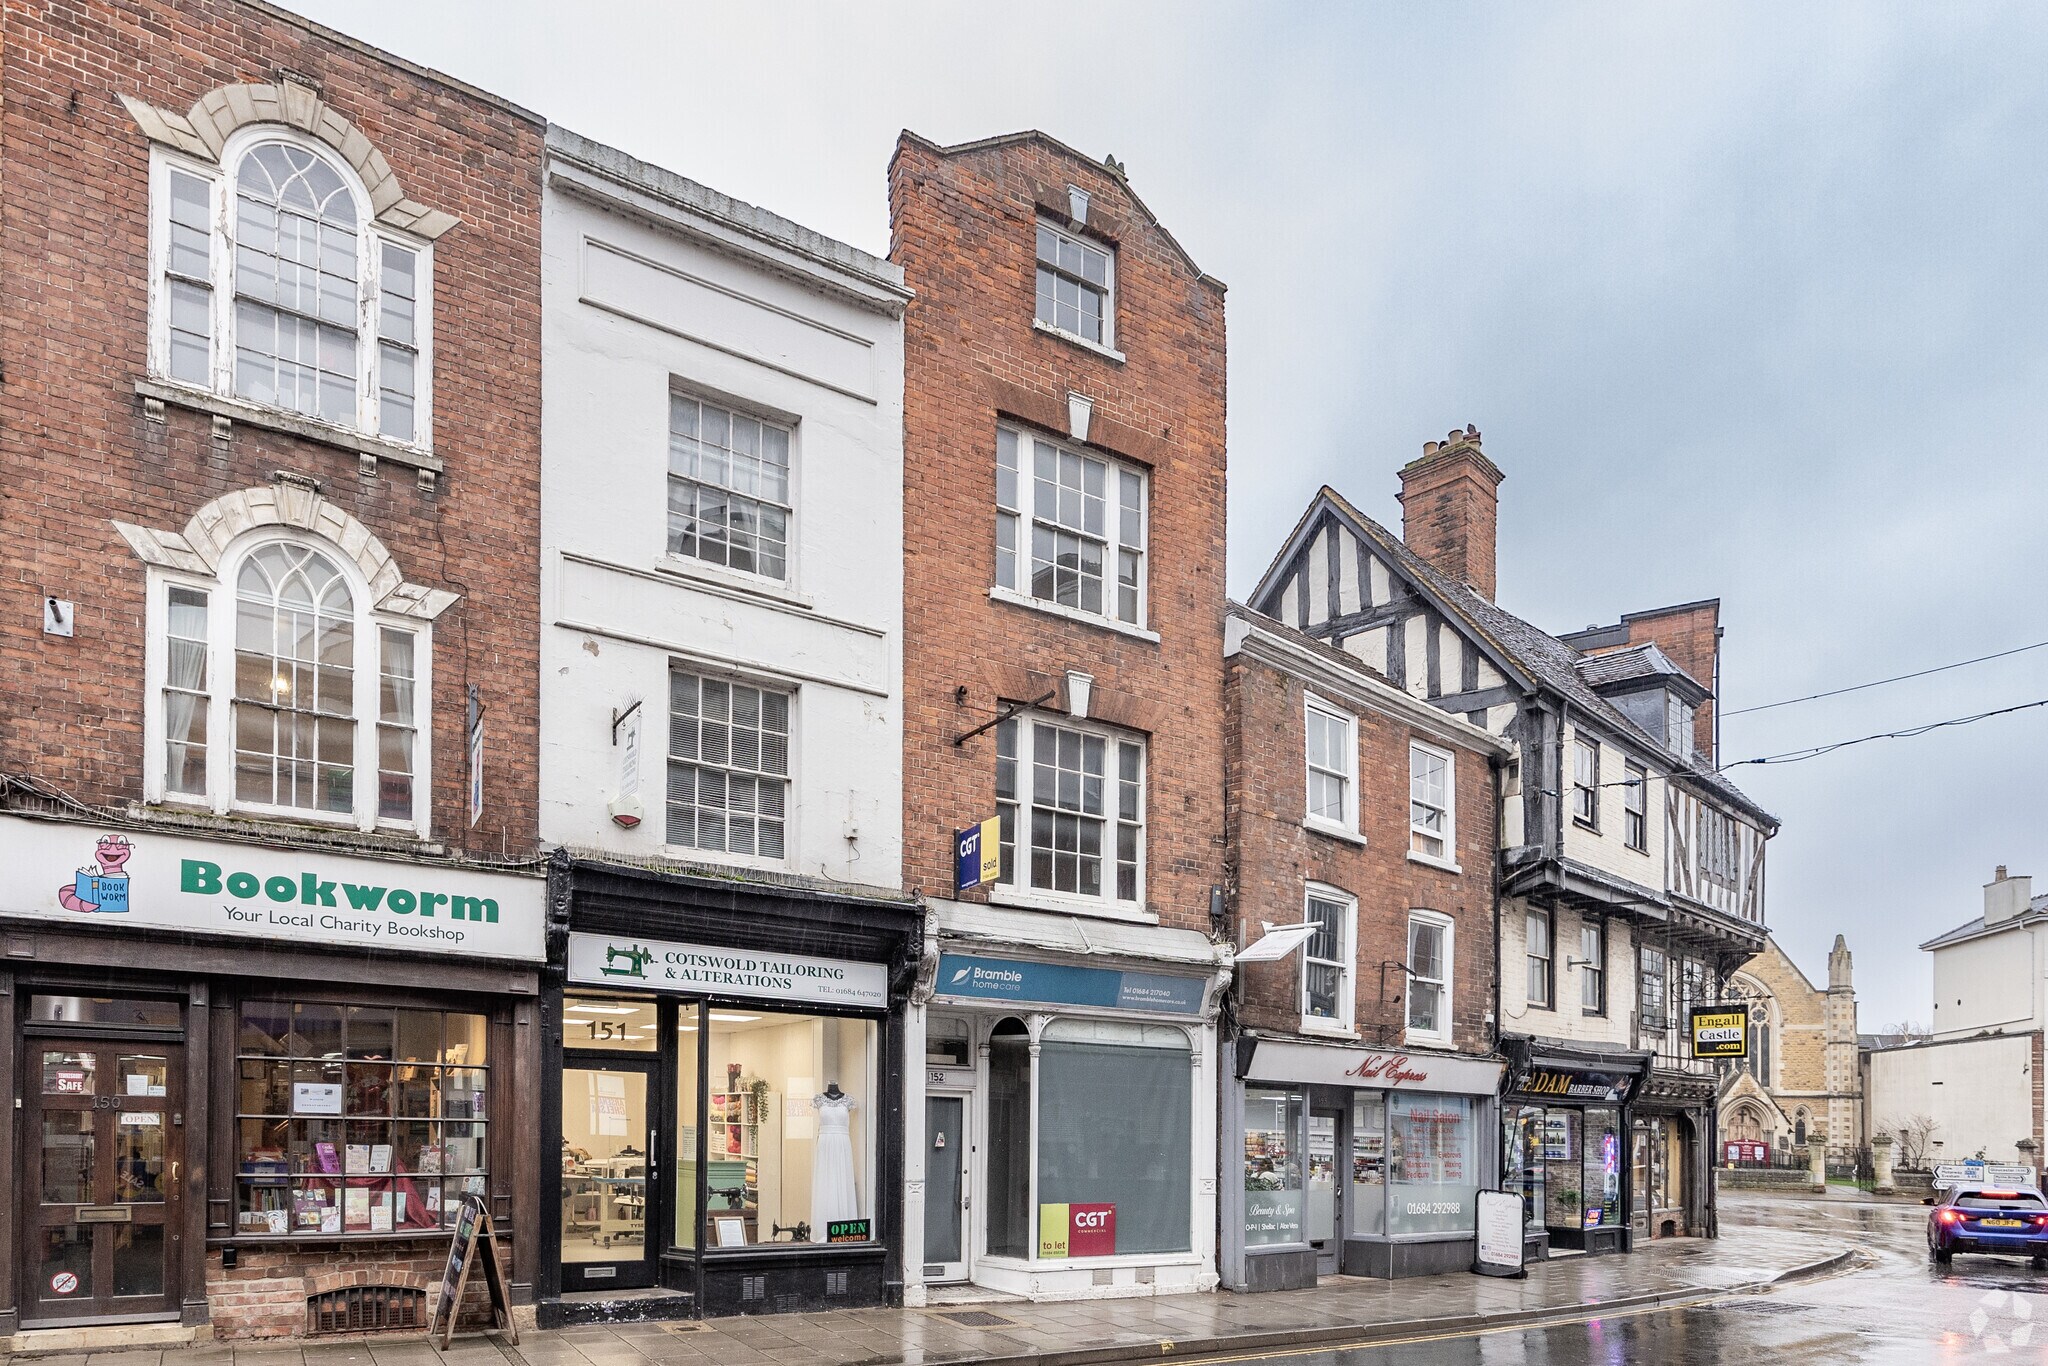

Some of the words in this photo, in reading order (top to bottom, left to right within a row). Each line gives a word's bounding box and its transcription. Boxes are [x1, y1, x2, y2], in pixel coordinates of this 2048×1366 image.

[960, 832, 978, 858] CGT
[983, 857, 996, 871] sold
[102, 882, 124, 892] BOOK
[181, 858, 499, 923] Bookworm
[100, 893, 126, 902] WORM
[223, 905, 263, 923] Your
[269, 910, 314, 928] Local
[320, 915, 382, 937] Charity
[388, 921, 465, 944] Bookshop
[665, 952, 757, 972] COTSWOLD
[760, 961, 844, 980] TAILORING
[665, 967, 677, 979] &
[681, 968, 792, 990] ALTERATIONS
[974, 967, 1022, 982] Bramble
[818, 986, 834, 994] TEL:
[836, 988, 856, 996] 01684
[856, 990, 882, 998] 647020
[1698, 1014, 1740, 1028] Engall
[586, 1021, 626, 1040] 151
[1700, 1029, 1740, 1040] Castle
[930, 1072, 944, 1081] 152
[1346, 1055, 1391, 1078] Nail
[1386, 1056, 1428, 1086] Express
[58, 1078, 83, 1091] SAFE
[1523, 1072, 1572, 1094] ADAM
[1568, 1084, 1594, 1095] BARBER
[92, 1096, 121, 1109] 150
[126, 1114, 155, 1123] OPEN
[1410, 1108, 1430, 1123] Nail
[1432, 1109, 1461, 1124] Salon
[1249, 1204, 1274, 1218] Beauty
[1282, 1203, 1296, 1216] Spa
[1407, 1202, 1431, 1214] 01684
[1432, 1202, 1460, 1214] 292988
[1075, 1211, 1108, 1227] CGT
[831, 1222, 866, 1234] OPEN
[831, 1234, 867, 1243] welcome
[1043, 1241, 1052, 1250] to
[1054, 1241, 1066, 1249] let
